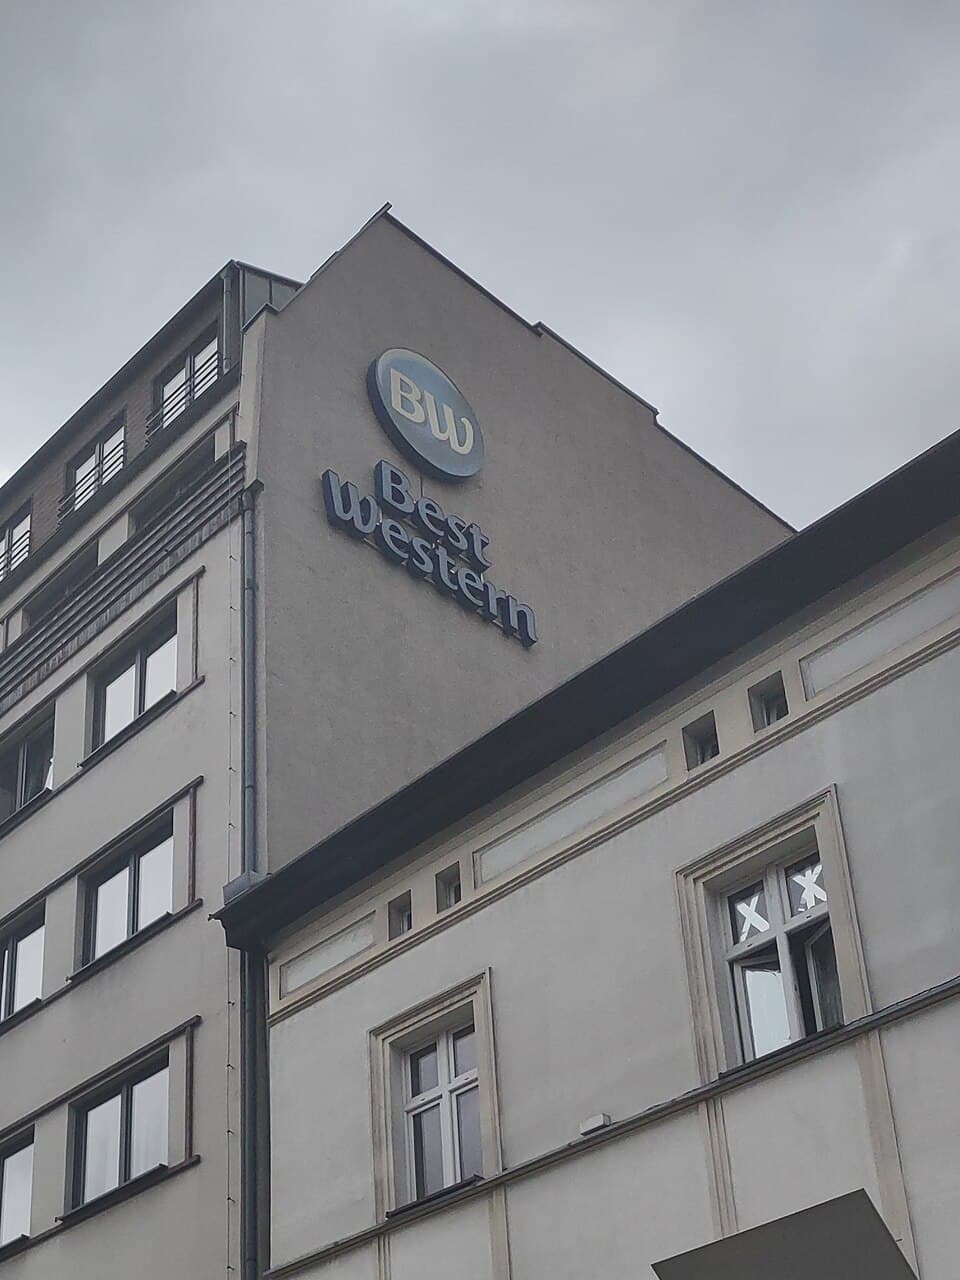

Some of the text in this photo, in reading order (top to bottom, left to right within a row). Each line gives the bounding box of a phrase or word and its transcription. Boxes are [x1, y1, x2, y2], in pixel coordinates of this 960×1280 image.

[389, 367, 475, 455] BW
[322, 468, 539, 649] Western
[375, 459, 493, 571] Best
